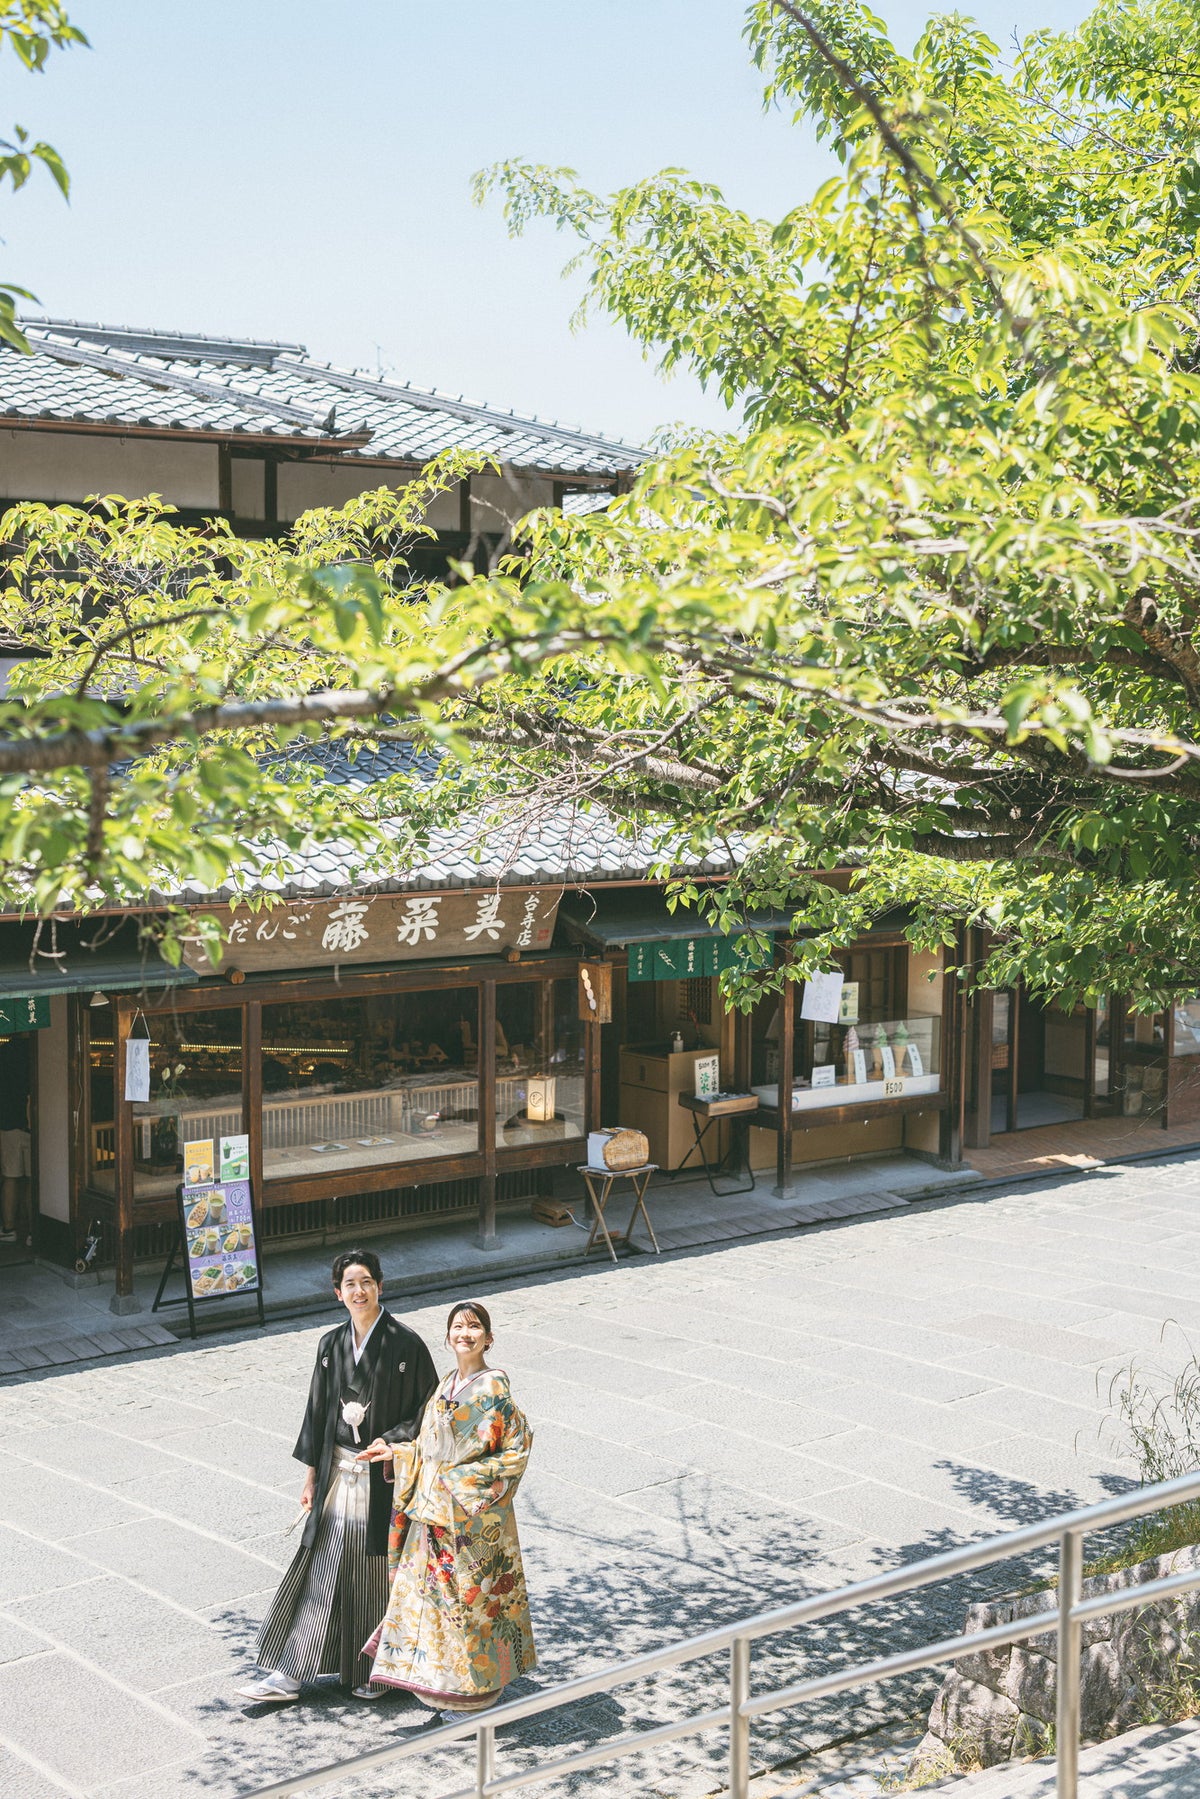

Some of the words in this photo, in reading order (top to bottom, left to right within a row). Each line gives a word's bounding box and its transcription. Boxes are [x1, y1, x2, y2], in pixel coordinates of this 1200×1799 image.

[516, 891, 541, 946] 台寺店
[886, 1082, 903, 1094] ¥500
